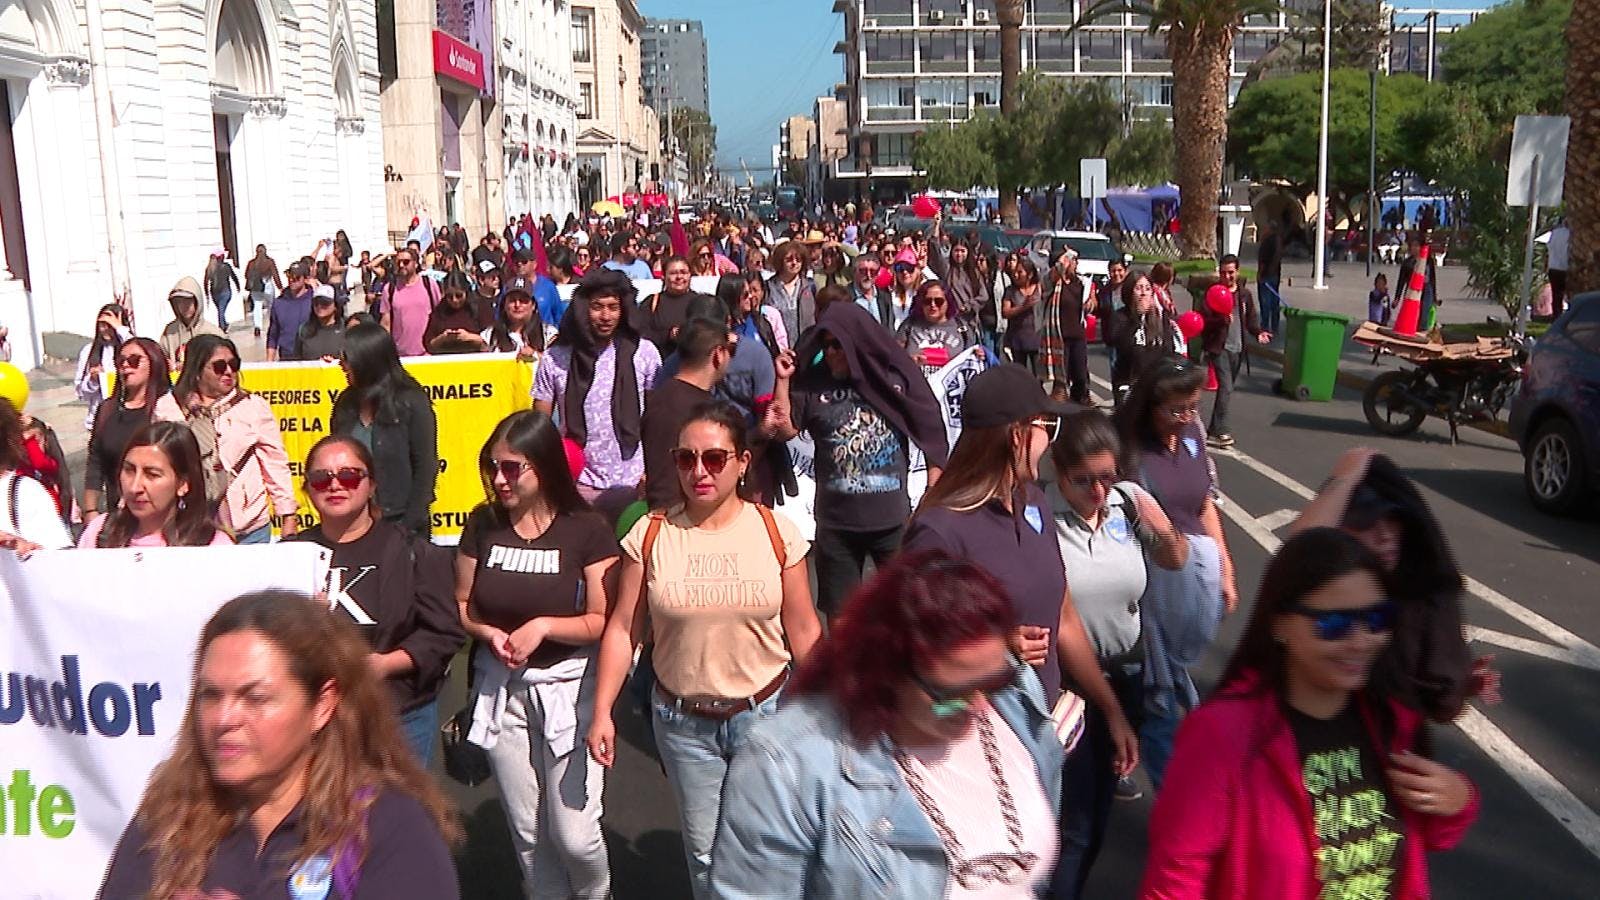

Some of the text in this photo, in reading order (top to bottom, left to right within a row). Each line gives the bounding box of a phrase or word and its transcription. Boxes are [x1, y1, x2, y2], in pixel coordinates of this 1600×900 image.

[279, 417, 323, 432] DE LA
[486, 544, 560, 574] PUMA
[685, 553, 739, 577] MON
[329, 566, 378, 625] K
[659, 579, 769, 609] AMOUR
[0, 769, 76, 839] te
